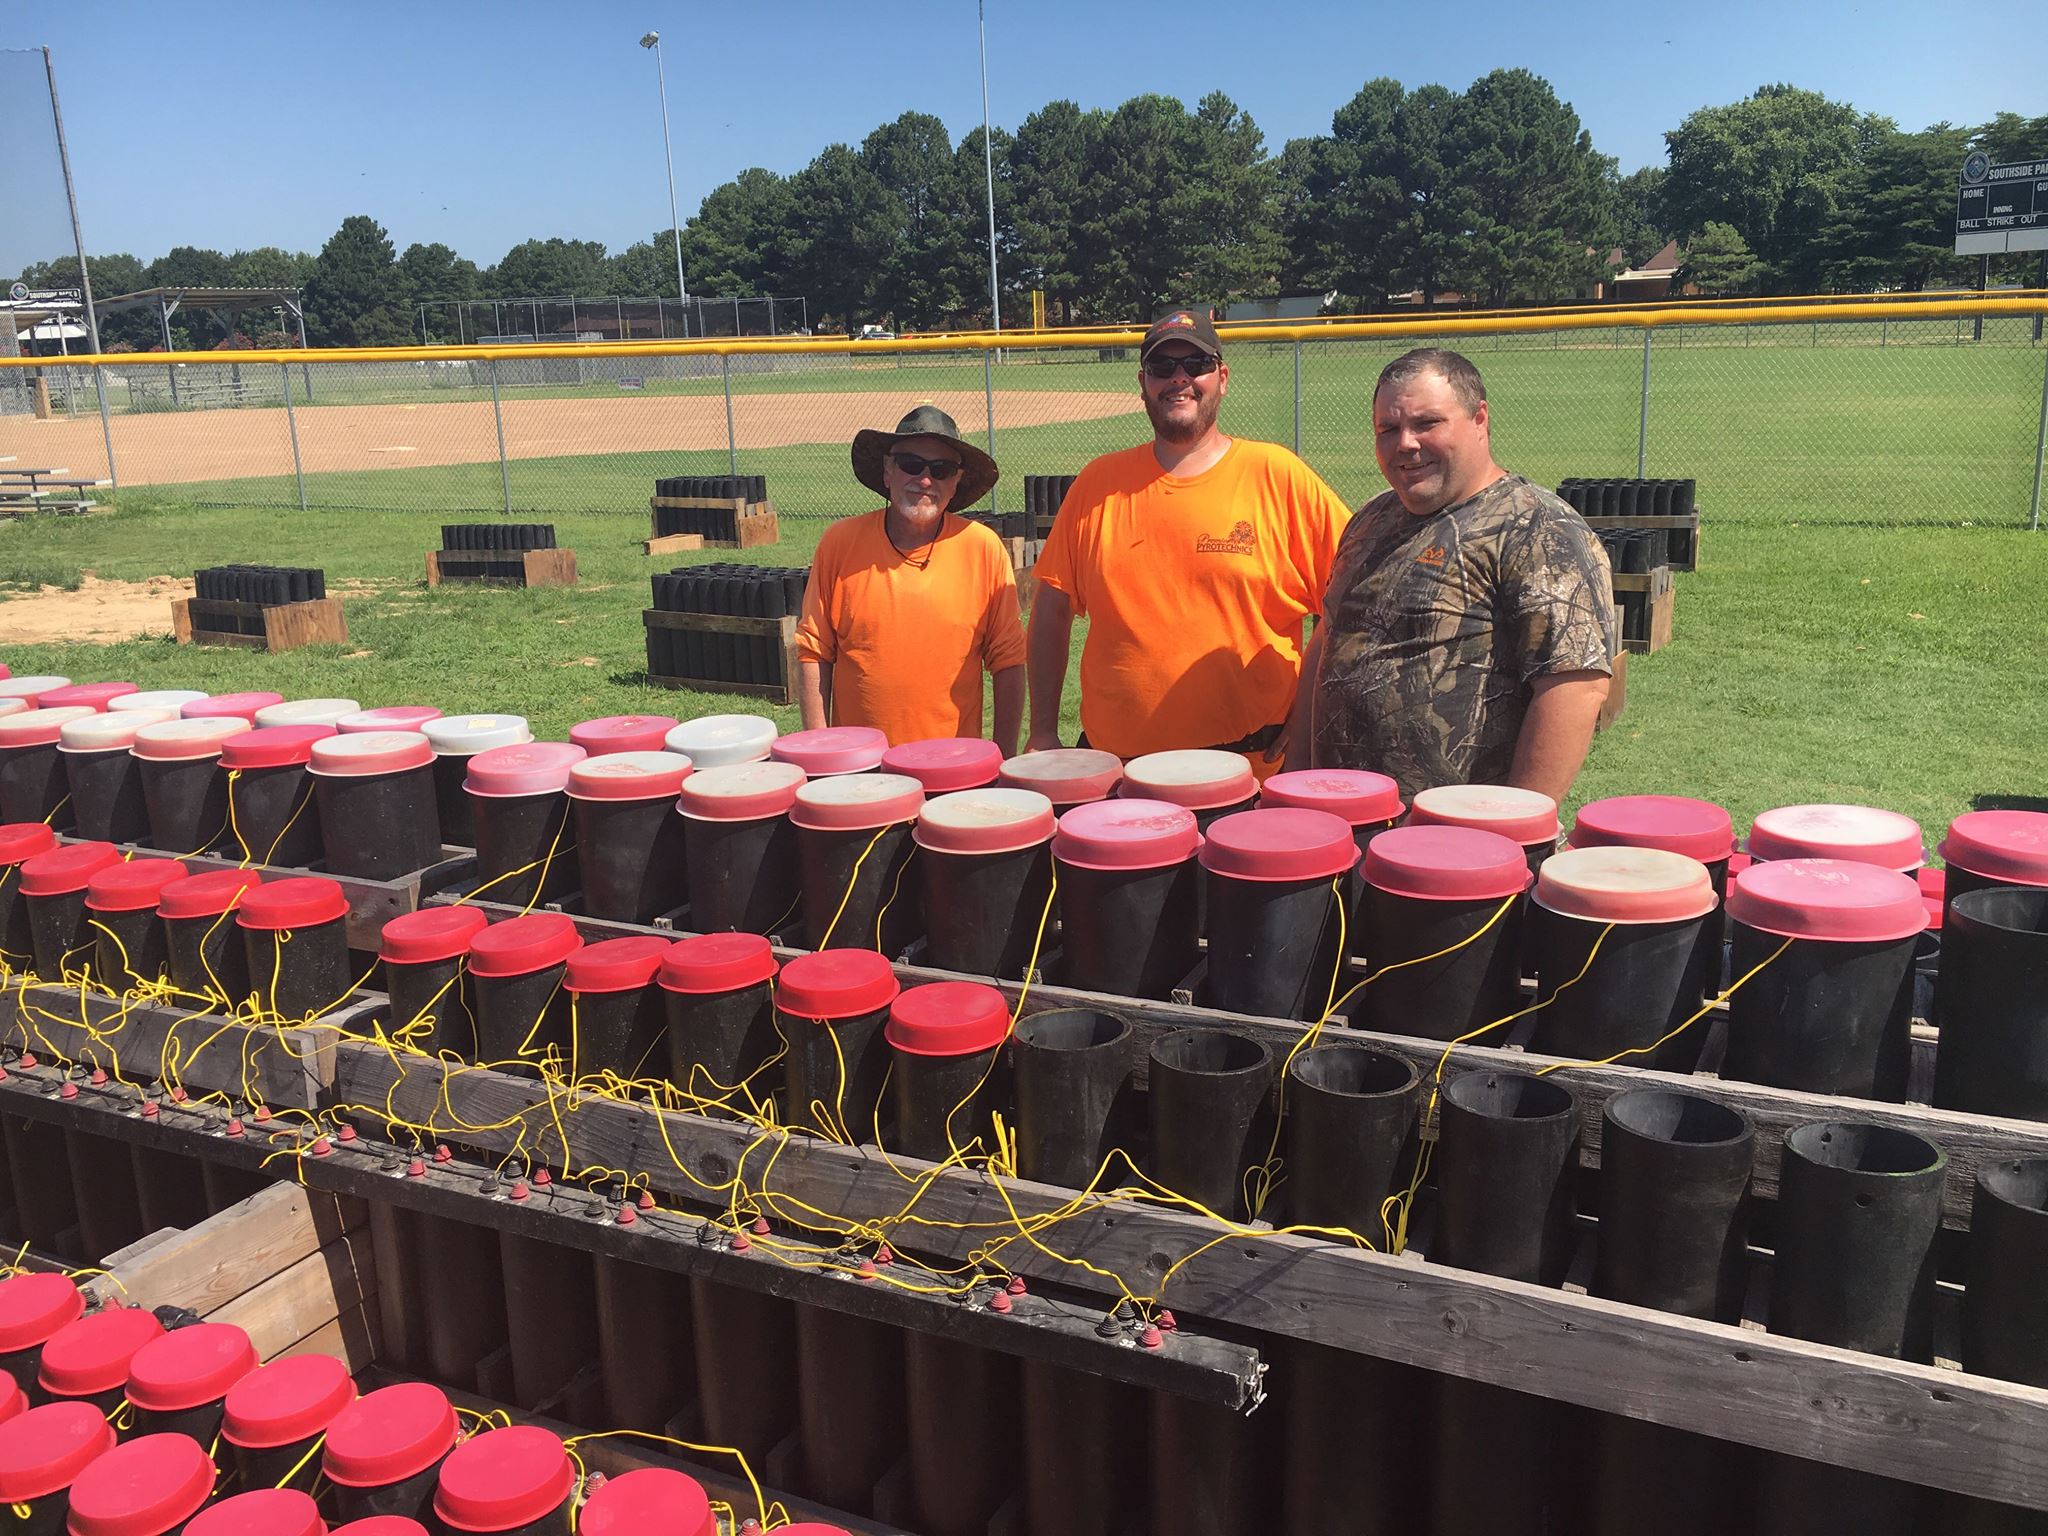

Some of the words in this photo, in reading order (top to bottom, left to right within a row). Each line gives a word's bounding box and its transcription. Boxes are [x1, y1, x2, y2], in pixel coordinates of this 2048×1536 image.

[1988, 165, 2033, 180] SOUTHSIDE
[1962, 188, 1985, 199] HOME
[1960, 219, 1980, 229] BALL
[1987, 215, 2015, 227] STRIKE
[2020, 214, 2038, 224] OUT
[1196, 543, 1253, 554] PYROTECHNICS
[836, 1272, 853, 1280] 30
[1119, 1338, 1136, 1349] 32
